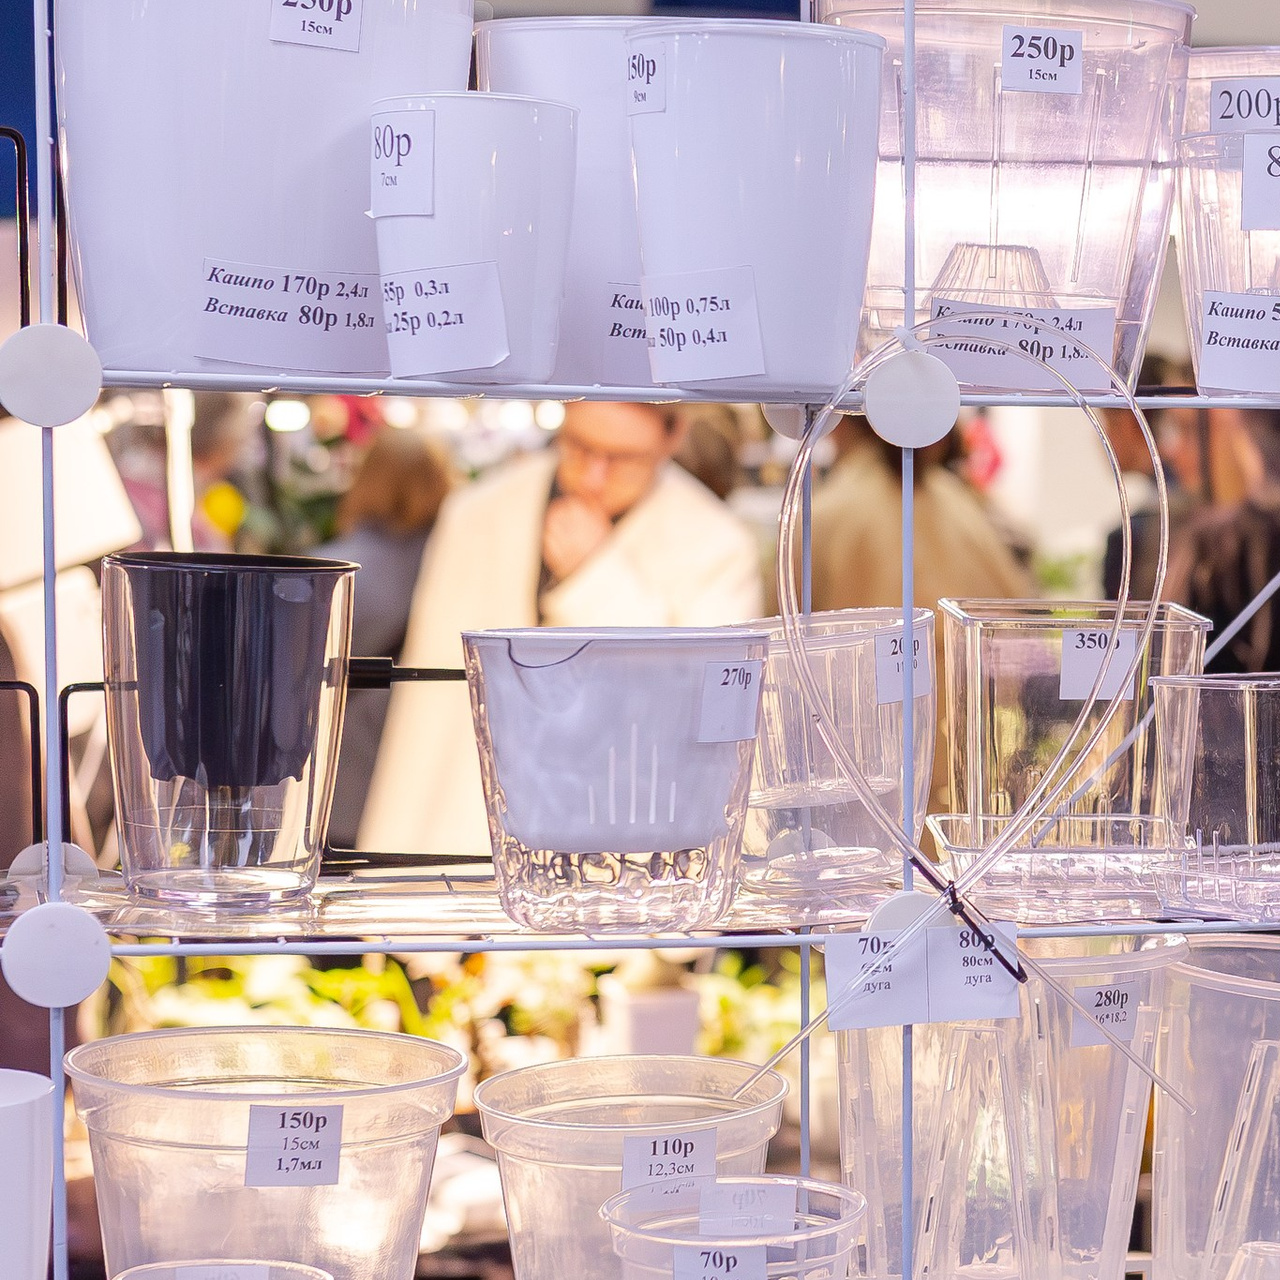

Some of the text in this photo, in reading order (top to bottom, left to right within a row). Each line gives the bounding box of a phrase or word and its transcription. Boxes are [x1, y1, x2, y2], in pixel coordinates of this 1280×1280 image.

[300, 19, 333, 35] 15см
[1010, 34, 1075, 68] 250р
[627, 53, 656, 84] 150р
[1028, 68, 1058, 81] 15см
[374, 124, 412, 167] 80р
[380, 172, 398, 186] 7см
[206, 266, 369, 301] Кашпо 170р 2,4л
[415, 280, 450, 298] 0,3л
[203, 297, 288, 323] Вставка
[299, 305, 338, 331] 80р
[345, 312, 375, 331] 1,8л
[650, 296, 731, 321] 100р 0,75л
[1206, 301, 1266, 320] Кашпо
[394, 311, 421, 336] 25р
[427, 310, 465, 329] 0,2л
[660, 327, 687, 352] 50р
[692, 327, 728, 348] 0,4л
[1205, 331, 1280, 351] Вставка
[720, 667, 752, 690] 270р
[962, 955, 993, 968] 80см
[964, 975, 992, 987] дуга
[1094, 988, 1129, 1009] 280р
[279, 1111, 328, 1133] 150р
[282, 1136, 321, 1150] 15см
[650, 1138, 695, 1159] 110р
[276, 1157, 322, 1173] 1,7мл
[647, 1162, 695, 1178] 12,3см
[700, 1250, 738, 1273] 70р
